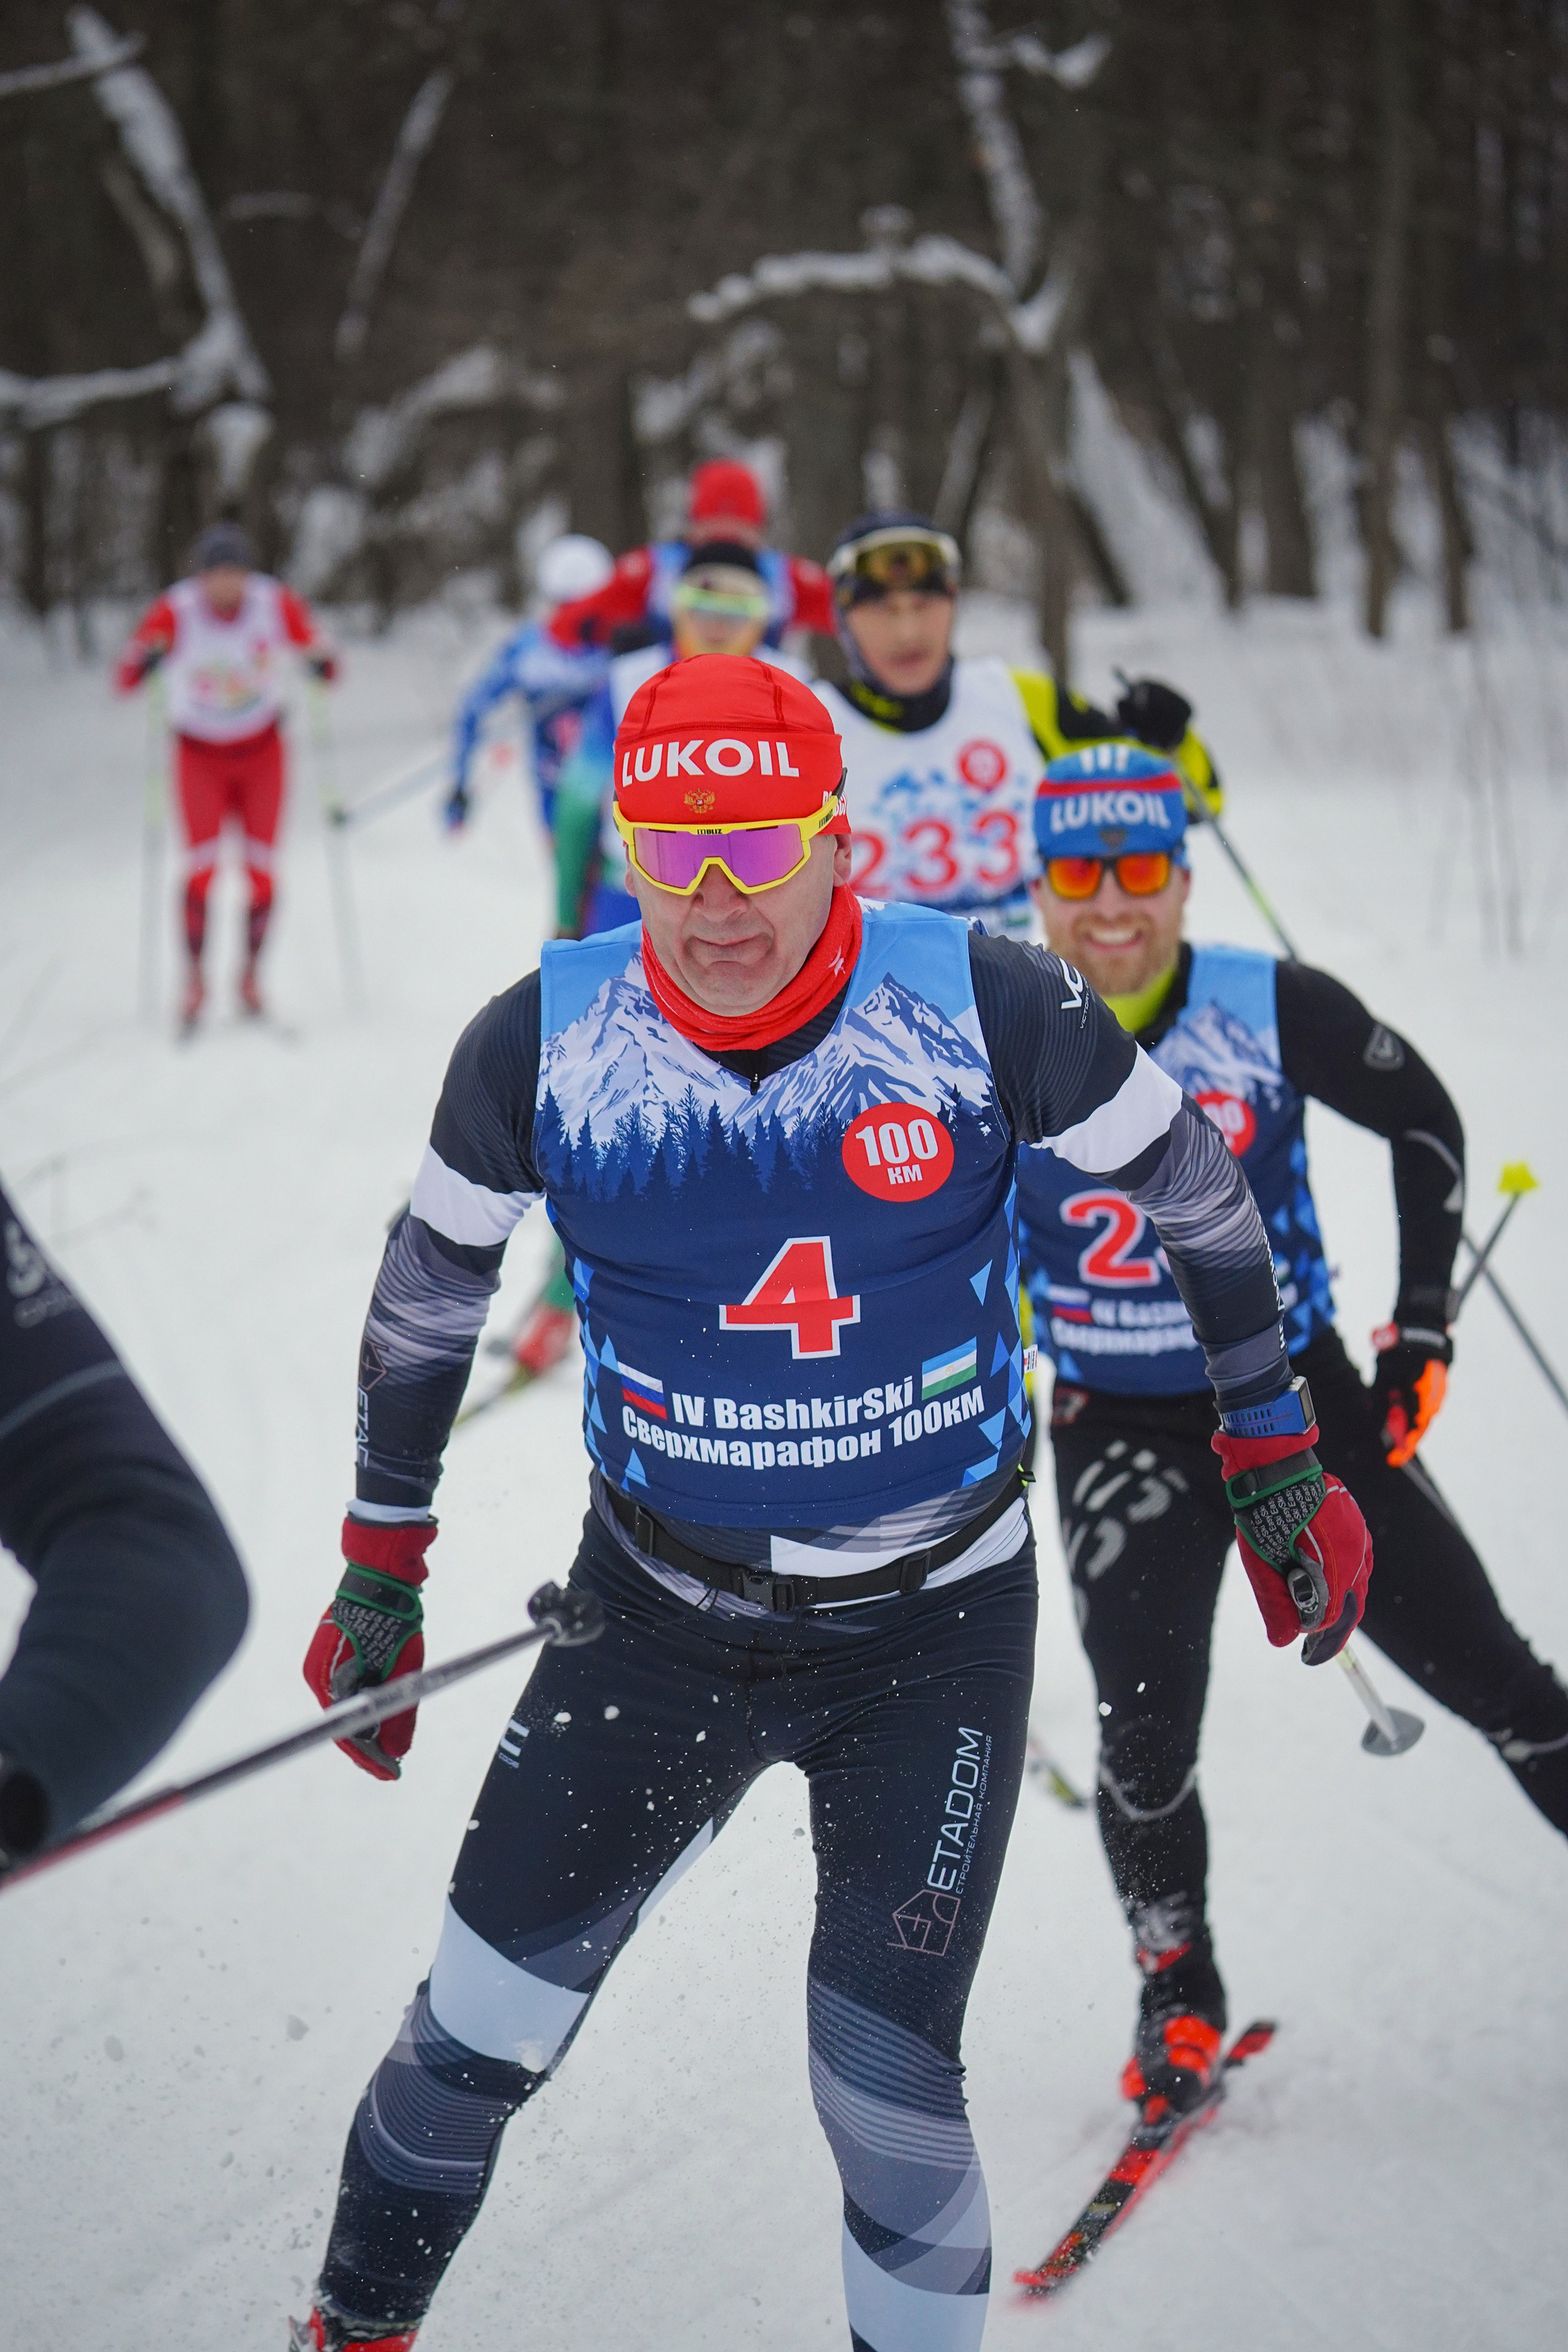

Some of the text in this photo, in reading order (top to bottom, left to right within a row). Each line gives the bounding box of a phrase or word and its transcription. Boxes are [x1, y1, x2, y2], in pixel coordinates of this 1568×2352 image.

[622, 739, 799, 787] LUKOIL
[1050, 791, 1171, 835] LUKOIL
[849, 809, 1022, 897] 233
[856, 1119, 938, 1166] 100
[719, 1236, 861, 1359] 4
[672, 1375, 913, 1430] IV BashkirSki
[623, 1405, 881, 1470] Сверхмарафон
[979, 1735, 992, 1800] КОМПАНИЯ
[927, 1727, 983, 1891] ETADOM
